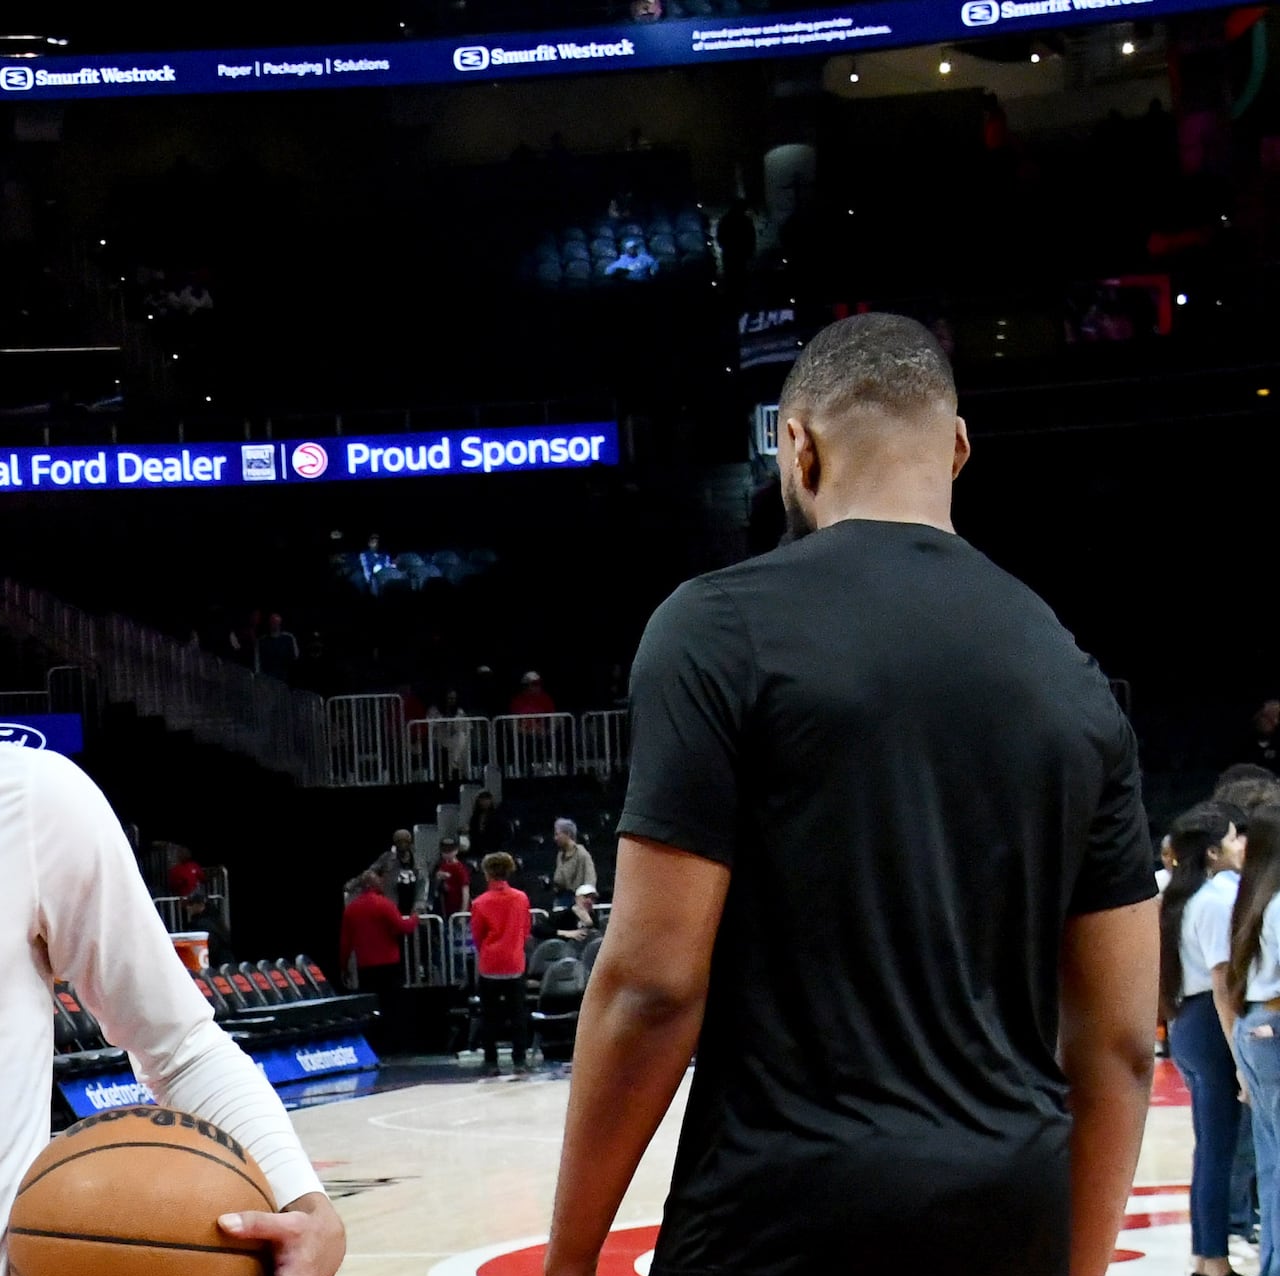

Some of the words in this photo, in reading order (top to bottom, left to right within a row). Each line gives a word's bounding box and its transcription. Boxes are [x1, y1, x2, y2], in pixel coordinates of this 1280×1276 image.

[1001, 0, 1075, 18] Smurfit
[491, 45, 558, 64] Smurfit
[557, 39, 634, 59] Westrock
[36, 68, 101, 85] Smurfit
[101, 65, 175, 83] Westrock
[218, 64, 252, 78] Paper
[264, 62, 323, 76] Packaging
[334, 59, 389, 72] Solutions
[346, 436, 451, 474] Proud
[461, 434, 606, 473] Sponsor
[32, 452, 106, 485] Ford
[118, 450, 226, 483] Dealer
[296, 1046, 358, 1072] ticketmaster
[85, 1082, 156, 1110] ticketmas
